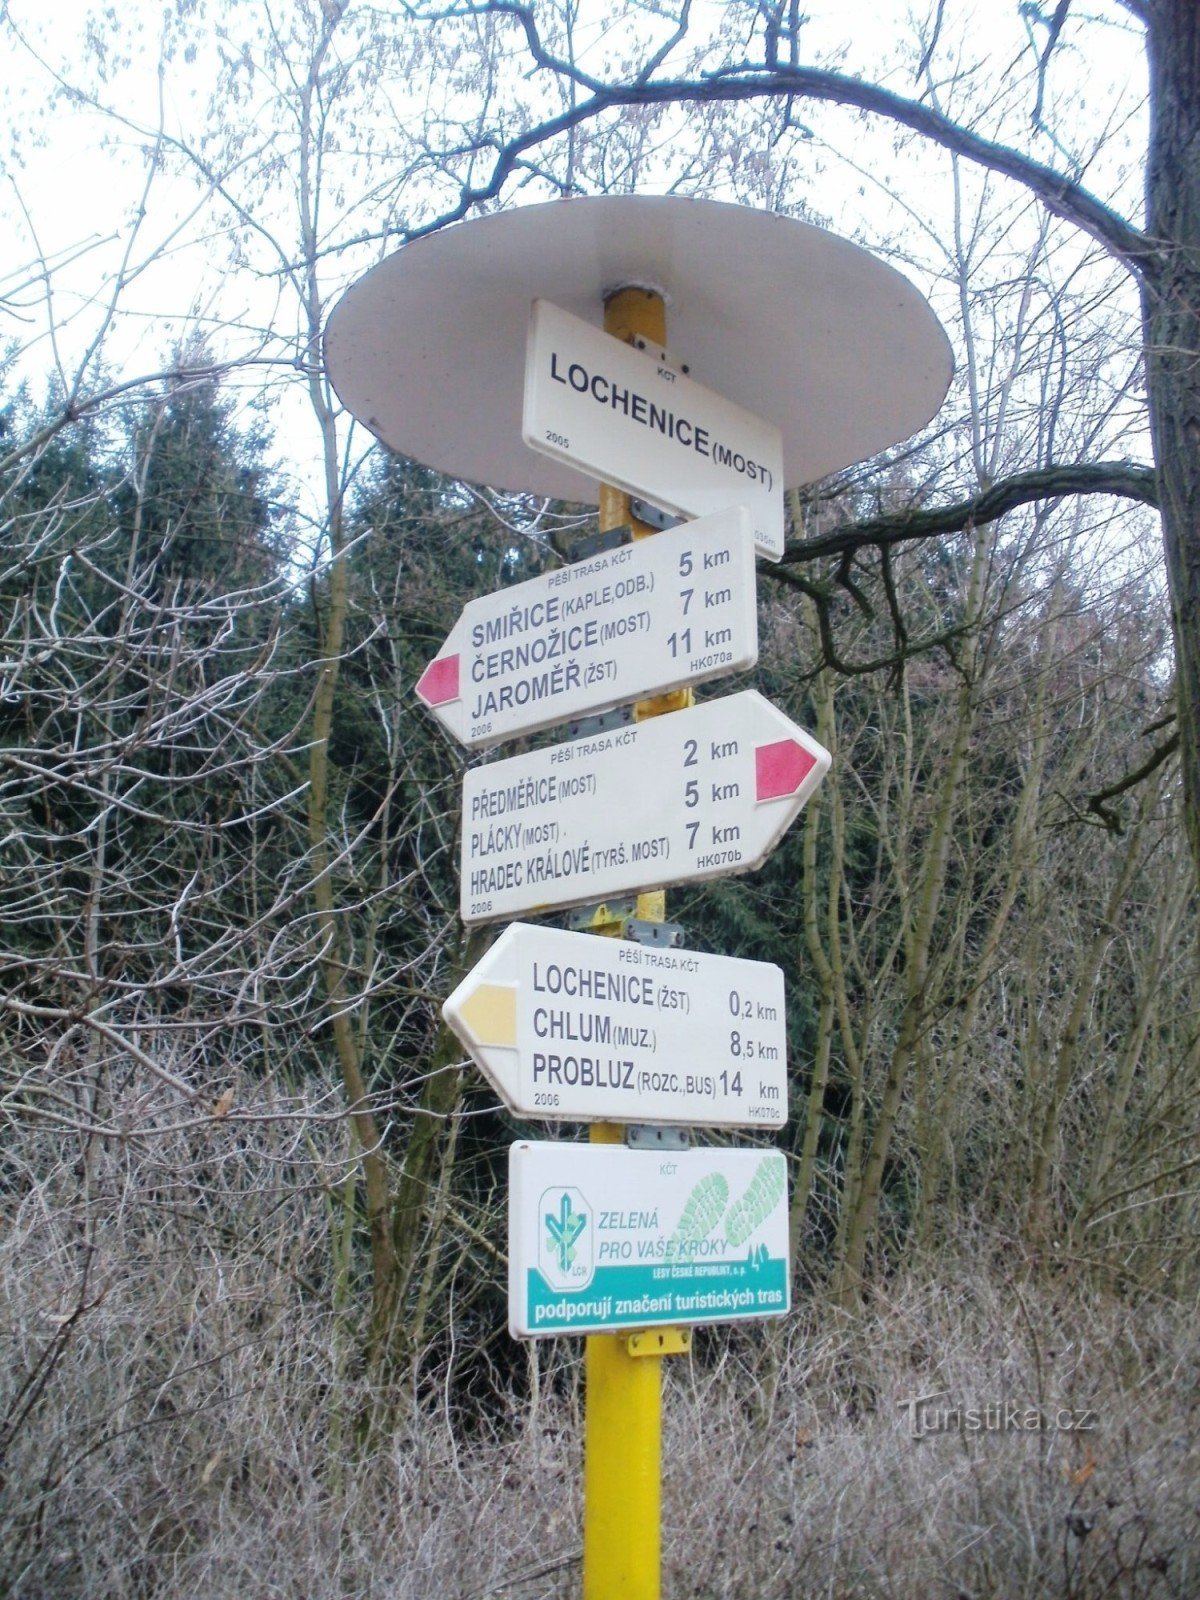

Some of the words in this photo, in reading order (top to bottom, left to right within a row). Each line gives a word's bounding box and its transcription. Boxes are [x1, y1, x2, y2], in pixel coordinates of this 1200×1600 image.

[545, 430, 570, 448] 2005
[573, 559, 609, 579] TRASA
[612, 550, 633, 567] KČT
[679, 551, 693, 577] 5
[703, 549, 730, 571] km
[680, 588, 695, 615] 7
[705, 586, 732, 608] km
[667, 628, 692, 658] 11
[705, 626, 732, 648] km
[690, 652, 733, 673] HK070a
[471, 722, 493, 738] 2006
[577, 739, 612, 758] TRASA
[615, 731, 637, 747] KČT
[683, 739, 698, 767] 2
[711, 738, 738, 761] km
[685, 779, 699, 808] 5
[712, 781, 739, 802] km
[471, 861, 523, 897] HRADEC
[631, 837, 670, 862] MOST)
[686, 821, 700, 850] 7
[712, 823, 740, 845] km
[697, 849, 742, 869] HK070b
[471, 900, 493, 915] 2006
[644, 954, 678, 970] TRASA
[680, 958, 699, 972] KČT
[729, 990, 753, 1020] 0,2
[757, 1002, 777, 1021] km
[730, 1030, 754, 1060] 8,5
[758, 1042, 778, 1061] km
[719, 1070, 743, 1097] 14
[759, 1081, 780, 1100] km
[534, 1093, 560, 1107] 2006
[598, 1208, 659, 1229] ZELENÁ
[599, 1240, 632, 1259] PRO
[637, 1235, 675, 1258] VAŠE
[679, 1237, 729, 1258] KROKY
[535, 1295, 611, 1323] podporují
[615, 1292, 672, 1315] značení
[675, 1288, 754, 1312] turistických
[757, 1287, 782, 1304] tras
